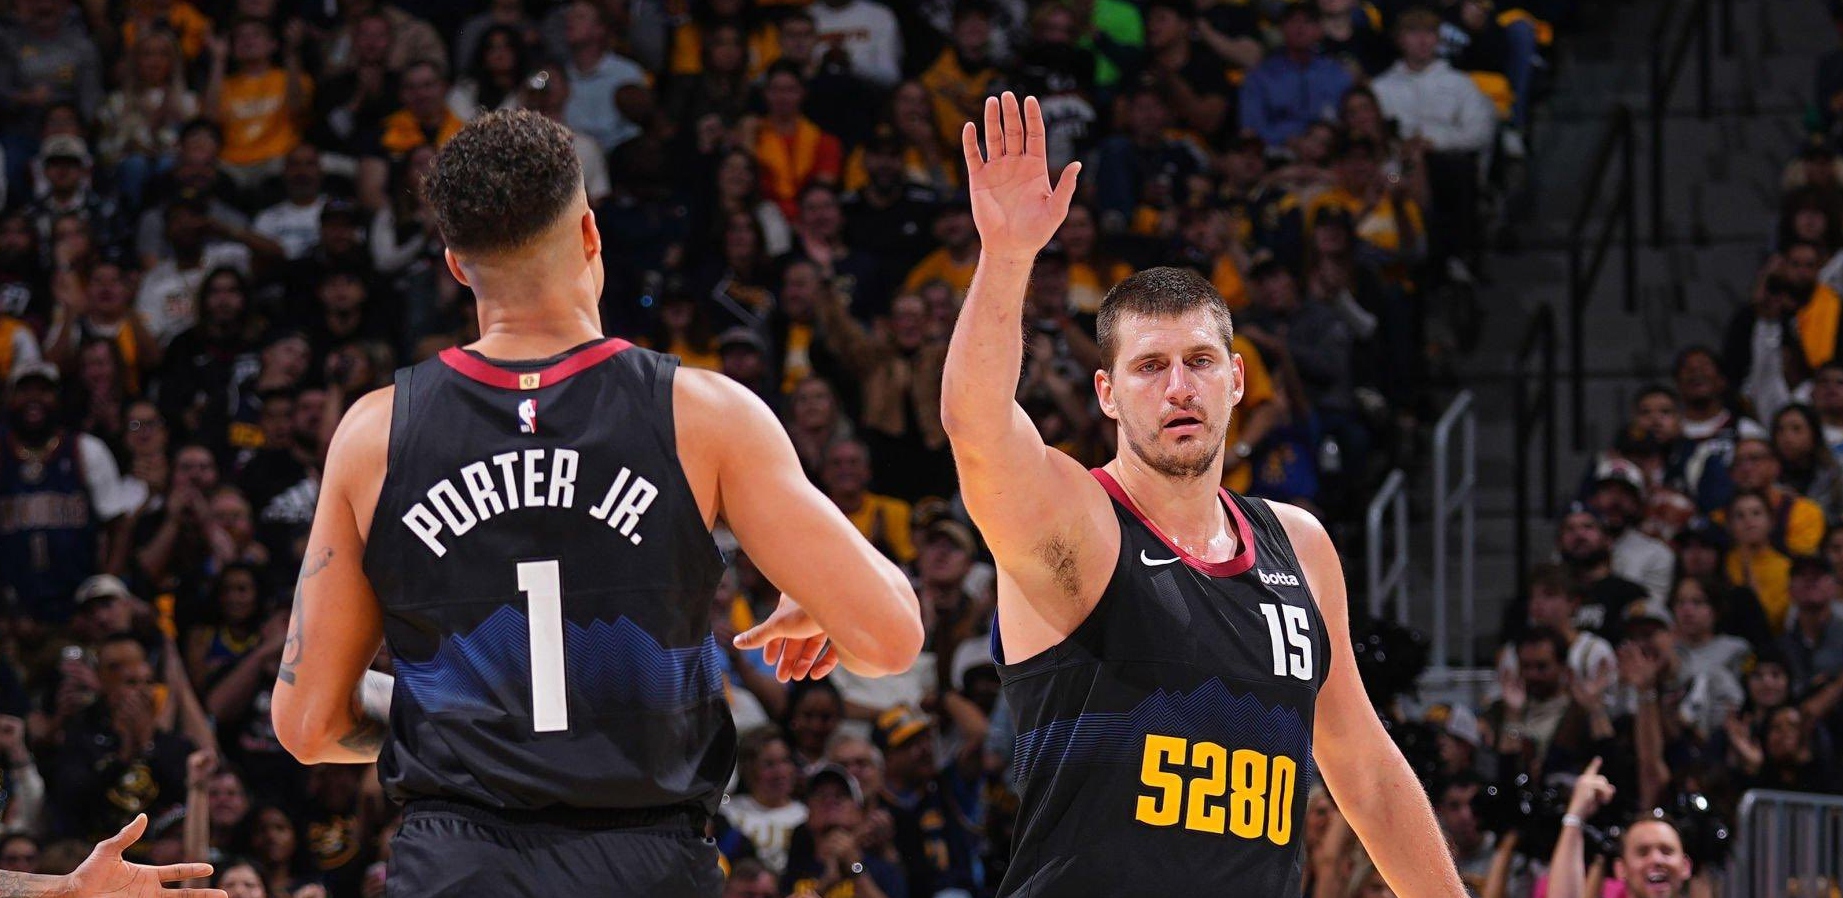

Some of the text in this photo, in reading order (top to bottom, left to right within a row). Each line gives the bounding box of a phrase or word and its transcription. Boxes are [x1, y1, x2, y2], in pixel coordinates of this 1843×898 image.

[402, 448, 579, 558] PORTER
[589, 466, 659, 546] JR.
[517, 560, 568, 732] 1
[1259, 603, 1313, 681] 15
[1135, 734, 1297, 846] 5280
